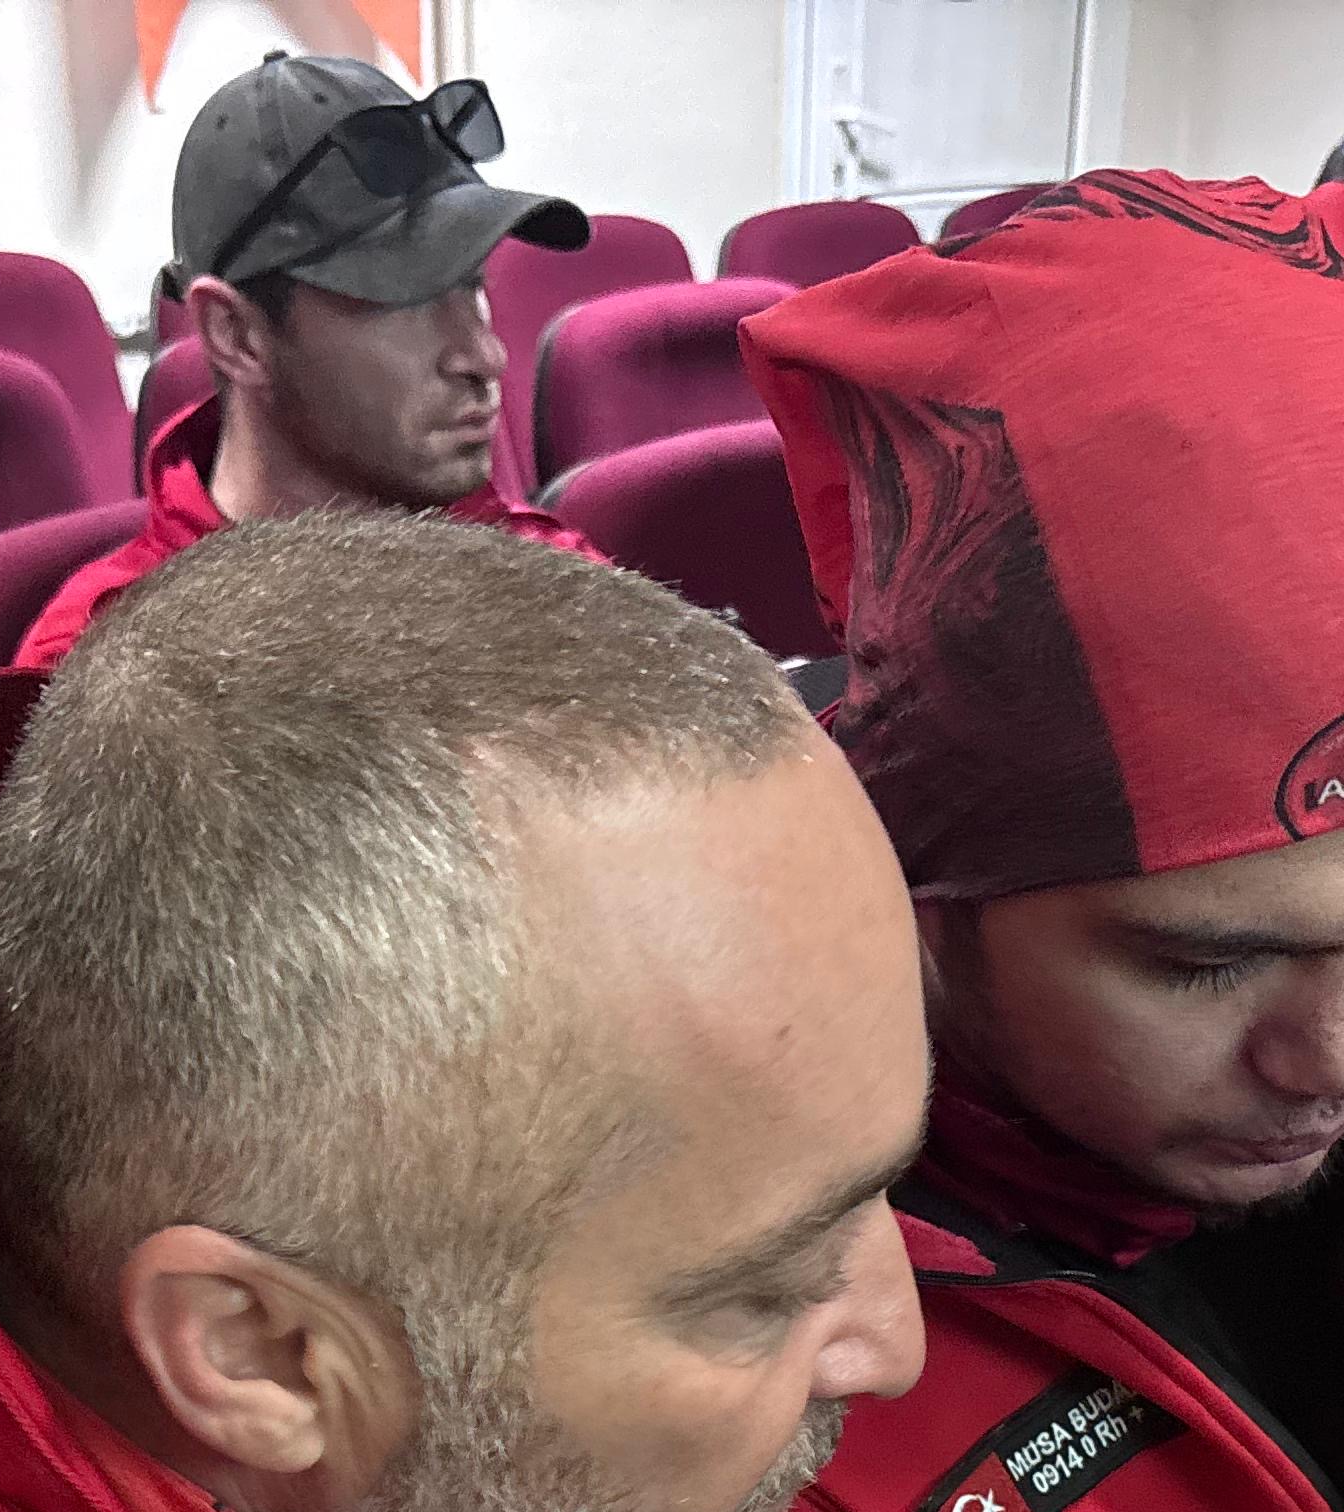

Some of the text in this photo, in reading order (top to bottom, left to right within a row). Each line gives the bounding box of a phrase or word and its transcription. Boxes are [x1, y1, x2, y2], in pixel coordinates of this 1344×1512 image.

[1006, 1422, 1073, 1481] MUSA
[1032, 1446, 1084, 1494] 0914
[1094, 1413, 1128, 1448] Rh
